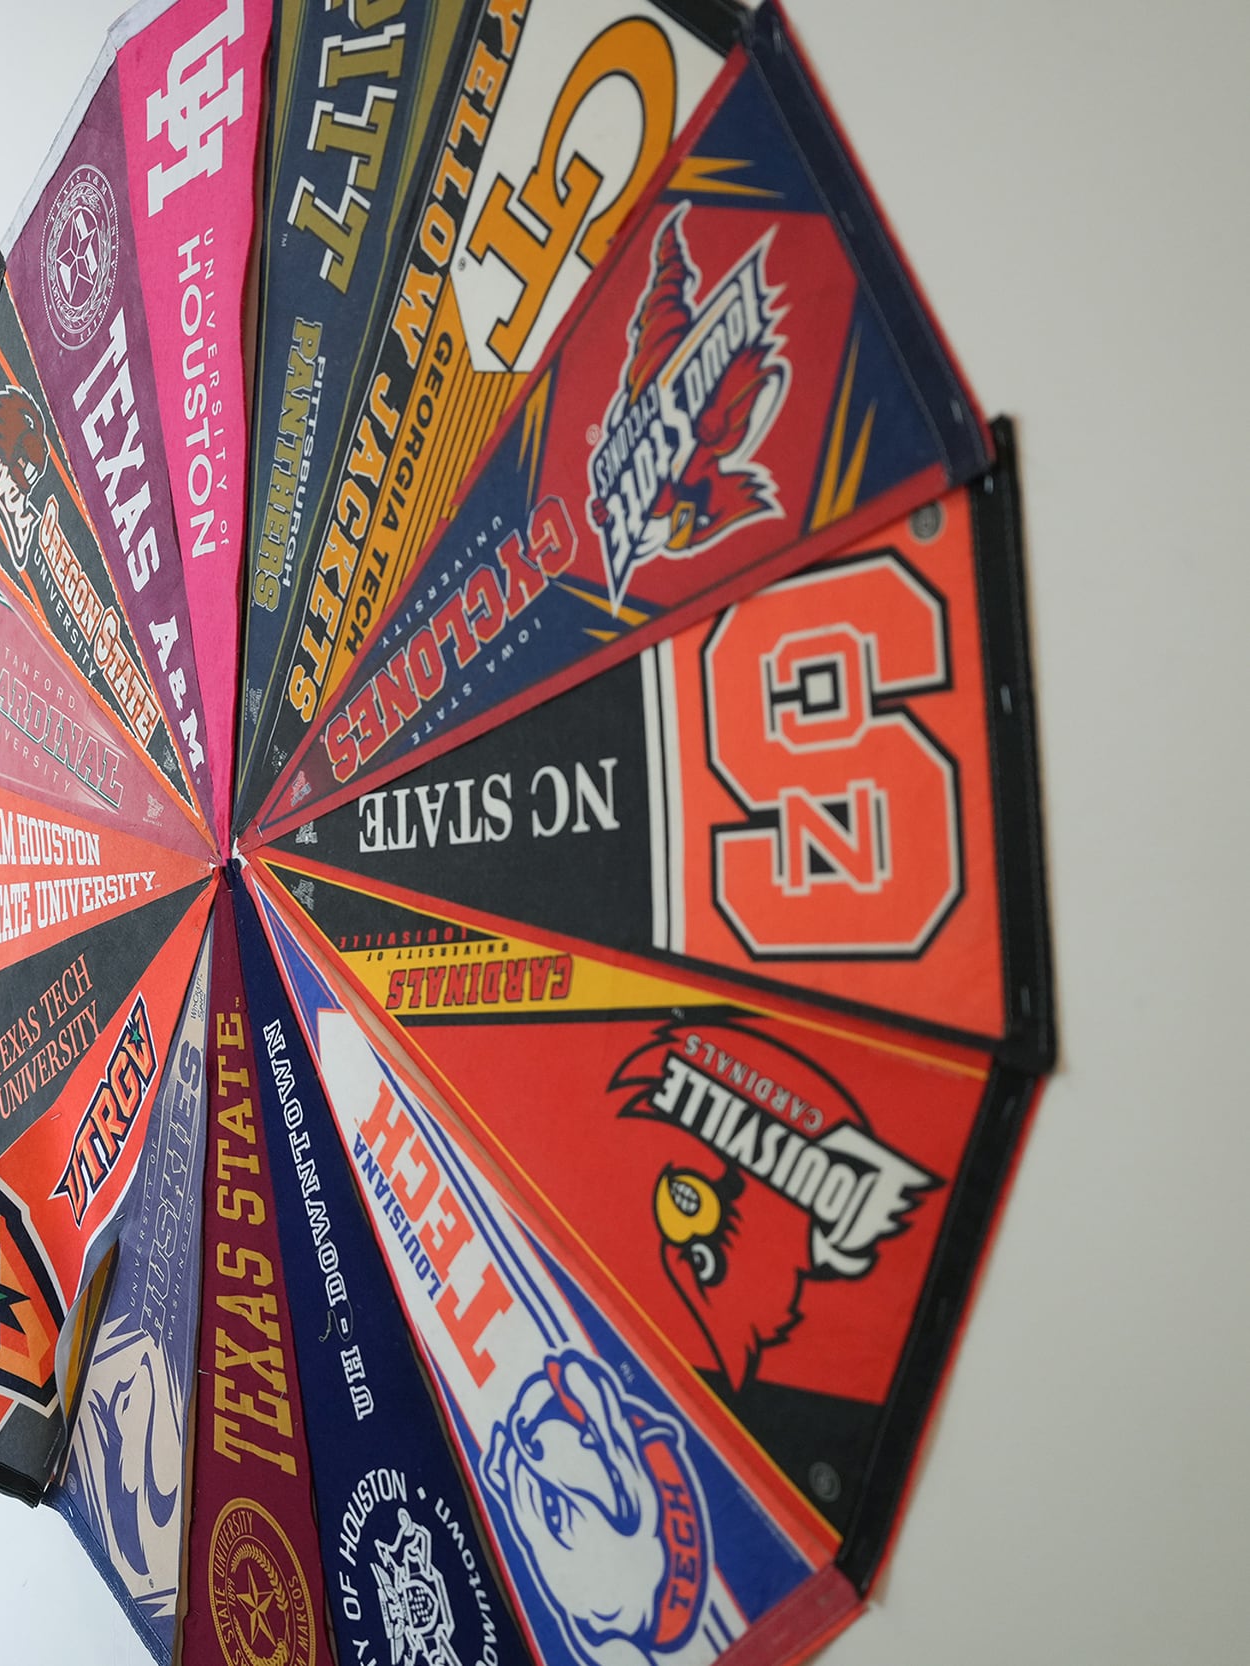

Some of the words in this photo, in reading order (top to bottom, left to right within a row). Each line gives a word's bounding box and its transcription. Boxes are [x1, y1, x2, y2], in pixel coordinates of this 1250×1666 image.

[392, 0, 529, 368] YELLOW
[178, 234, 215, 558] HOUSTON
[203, 228, 228, 490] UNIVERSITY
[72, 307, 161, 593] TEXAS
[253, 317, 322, 612] PANTHERS
[283, 356, 326, 587] PITTSBURGH
[375, 332, 453, 532] GEORGIA
[289, 373, 401, 723] JACKETS
[347, 546, 390, 657] TECH
[380, 516, 502, 649] UNIVERSITY
[34, 553, 97, 684] UNIVERSITY
[40, 496, 104, 638] OREGON
[96, 606, 163, 745] STATE
[324, 496, 578, 783] CYCLONES
[486, 618, 542, 673] IOWA
[412, 684, 472, 745] STATE
[18, 815, 101, 867] HOUSTON
[358, 772, 513, 853] STATE
[530, 757, 621, 838] NC
[35, 870, 157, 932] UNIVERSITY
[339, 927, 467, 947] LOUISVILLE
[366, 951, 383, 962] OF
[397, 943, 509, 960] UNIVERSITY
[39, 953, 94, 1026] TECH
[386, 952, 574, 1010] CARDINALS
[49, 995, 158, 1228] UTRGV
[216, 1012, 269, 1226] STATE
[684, 1035, 824, 1132] CARDINALS
[131, 1174, 154, 1307] UNIVERSITY
[149, 1137, 158, 1167] OF
[140, 1040, 202, 1348] HUSKIES
[263, 1019, 345, 1306] DOWNTOWN
[352, 1133, 443, 1301] LOUISIANA
[653, 1056, 935, 1276] LOUISVILLE
[166, 1193, 196, 1342] WASHINGTON
[360, 1079, 514, 1389] TECH
[213, 1243, 297, 1477] TEXAS
[340, 1345, 375, 1420] UH
[213, 1510, 253, 1578] UNIVERSITY
[339, 1468, 407, 1567] HOUSTON
[660, 1478, 698, 1610] TECH
[215, 1587, 234, 1644] STATE
[228, 1577, 236, 1607] 1899
[289, 1575, 309, 1652] MARCOS
[339, 1571, 361, 1621] OF
